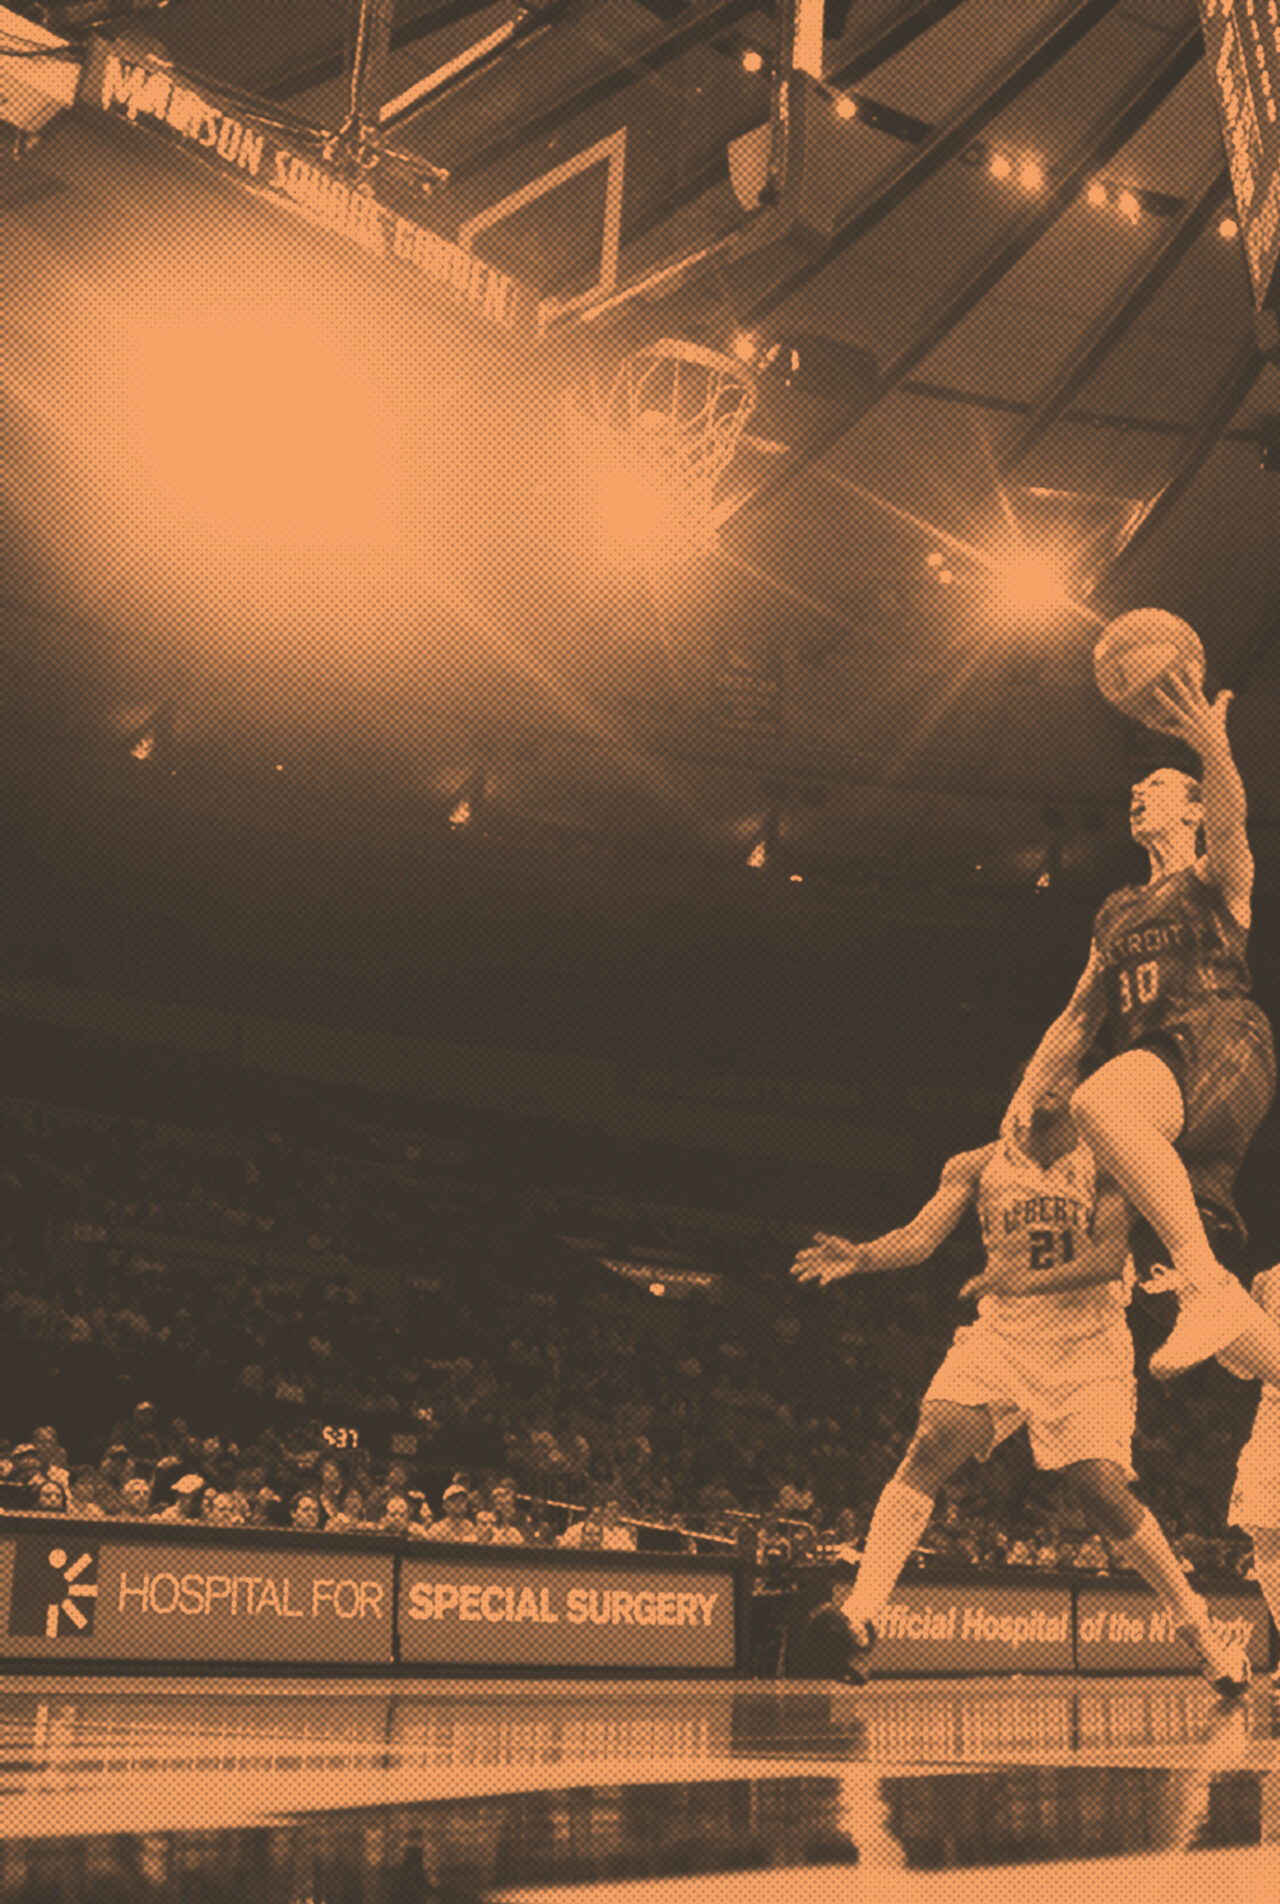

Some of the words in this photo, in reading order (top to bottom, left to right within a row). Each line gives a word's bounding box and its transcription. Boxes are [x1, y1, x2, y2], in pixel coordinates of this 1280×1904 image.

[1118, 960, 1160, 1013] 10
[1028, 1229, 1074, 1270] 21
[118, 1571, 303, 1618] HOSPITAL
[311, 1578, 384, 1619] FOR
[408, 1582, 559, 1623] SPECIAL
[566, 1587, 718, 1626] SURGERY
[877, 1604, 957, 1640] fficial
[961, 1606, 1069, 1651] Hospital
[1108, 1610, 1145, 1643] the
